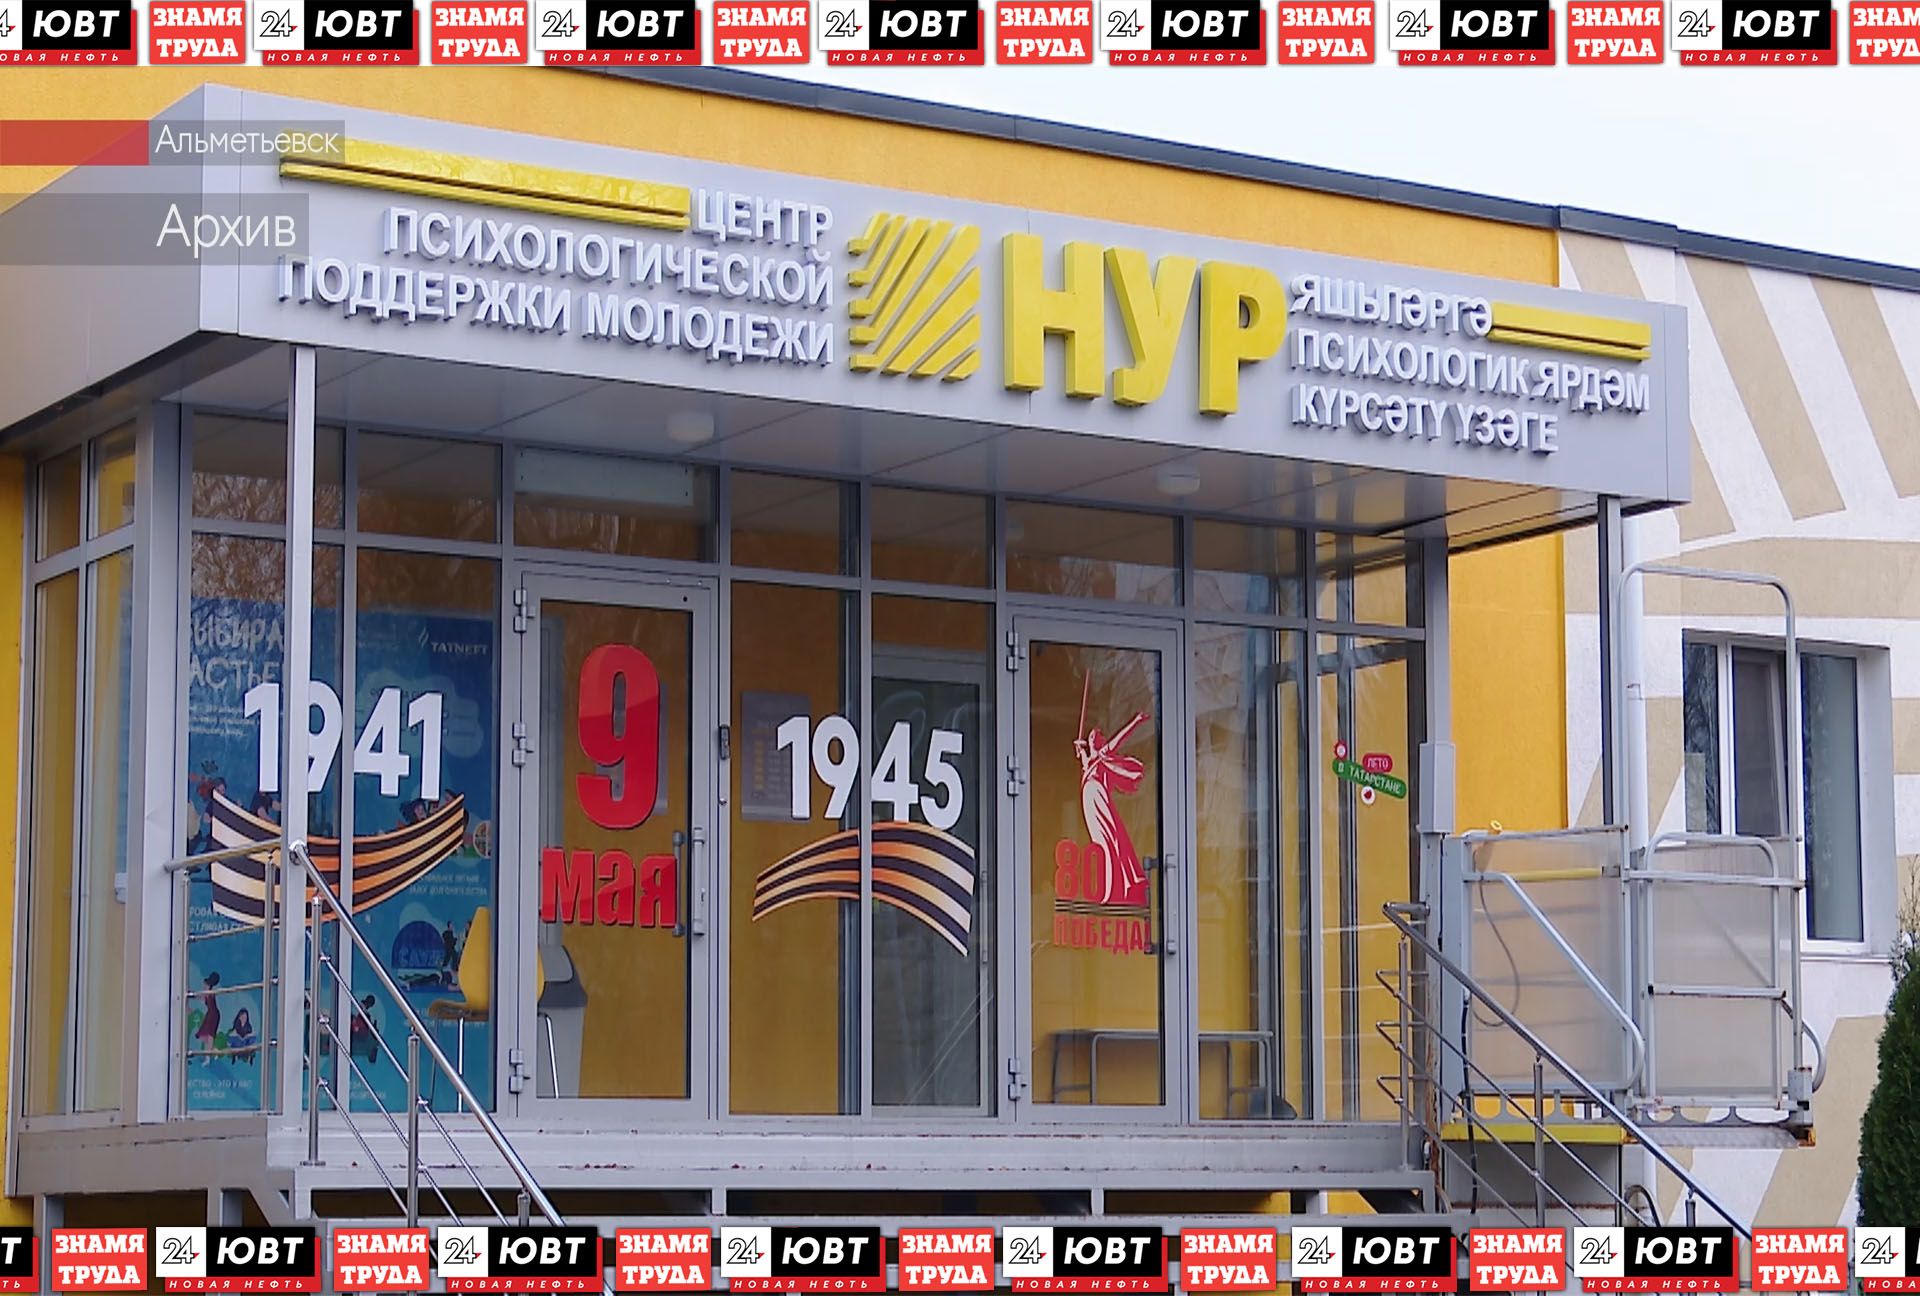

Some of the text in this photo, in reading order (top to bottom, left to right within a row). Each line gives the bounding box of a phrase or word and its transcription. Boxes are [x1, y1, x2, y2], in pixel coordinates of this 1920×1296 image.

[385, 206, 834, 308] ПСИХОЛОГИЧЕСКОЙ
[693, 188, 834, 247] ЦЕНТР
[279, 254, 834, 365] ПОДДЕРЖКИ МОЛОДЕЖИ
[1003, 233, 1287, 417] НУР
[1290, 273, 1493, 338] ЯШЬЛӘРГӘ
[1292, 329, 1651, 413] ПСИХОЛОГИК ЯРДӘМ
[191, 612, 284, 652] ЫБИРА
[244, 681, 443, 800] 1941
[576, 643, 661, 830] 9
[777, 714, 964, 831] 1945
[1055, 839, 1105, 903] 80
